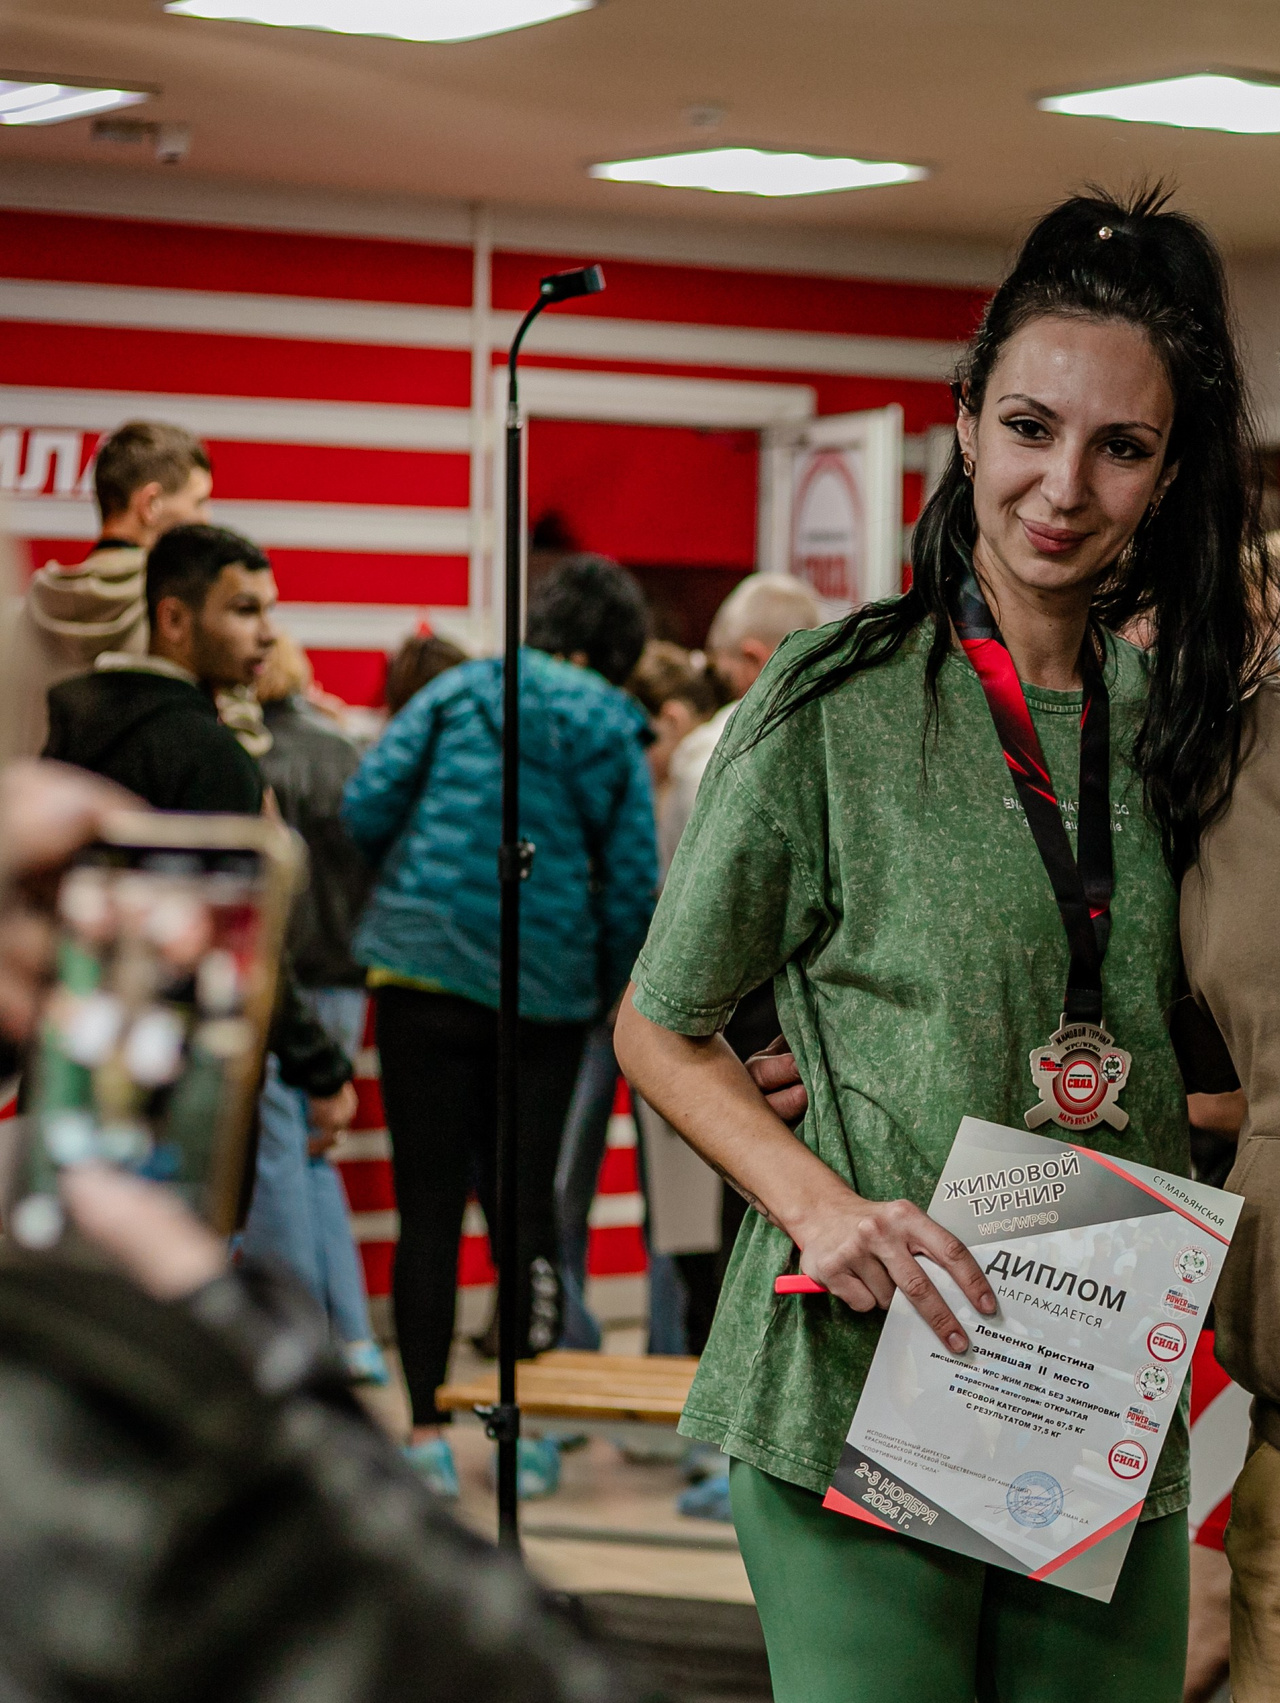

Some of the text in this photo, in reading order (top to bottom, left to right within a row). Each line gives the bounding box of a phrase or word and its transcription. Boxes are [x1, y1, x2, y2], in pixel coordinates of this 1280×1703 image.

[1055, 1026, 1111, 1046] ЖИМОВОЙ ТУРНИР
[943, 1151, 1081, 1201] ЖИМОВОЙ
[969, 1182, 1067, 1217] ТУРНИР
[978, 1211, 1059, 1236] WPC/WPSO
[985, 1250, 1128, 1313] ДИПЛОМ
[1166, 1293, 1188, 1307] POWER
[997, 1285, 1103, 1329] НАГРАЖДАЕТСЯ
[975, 1324, 1095, 1371] Левченко Кристина
[1152, 1336, 1179, 1352] СИЛА
[930, 1352, 1121, 1419] дисциплина: WPC ЖИМ ЛЕЖА БЕЗ ЭКИПИРОВКИ
[972, 1345, 1032, 1371] занявшая
[1053, 1372, 1090, 1390] место
[954, 1373, 1089, 1421] возрастная категория: ОТКРЫТАЯ
[956, 1387, 995, 1405] ВЕСОВОЙ
[996, 1401, 1043, 1421] КАТЕГОРИИ
[1044, 1418, 1055, 1426] до
[1056, 1420, 1073, 1433] 67,5
[1074, 1426, 1086, 1435] КГ
[973, 1405, 1031, 1429] РЕЗУЛЬТАТОМ
[1032, 1423, 1049, 1436] 37,5
[1050, 1431, 1062, 1439] КГ
[1127, 1411, 1149, 1424] POWER
[1113, 1453, 1140, 1470] СИЛА
[854, 1462, 939, 1526] 2-3 НОЯБРЯ
[861, 1487, 900, 1519] 2024
